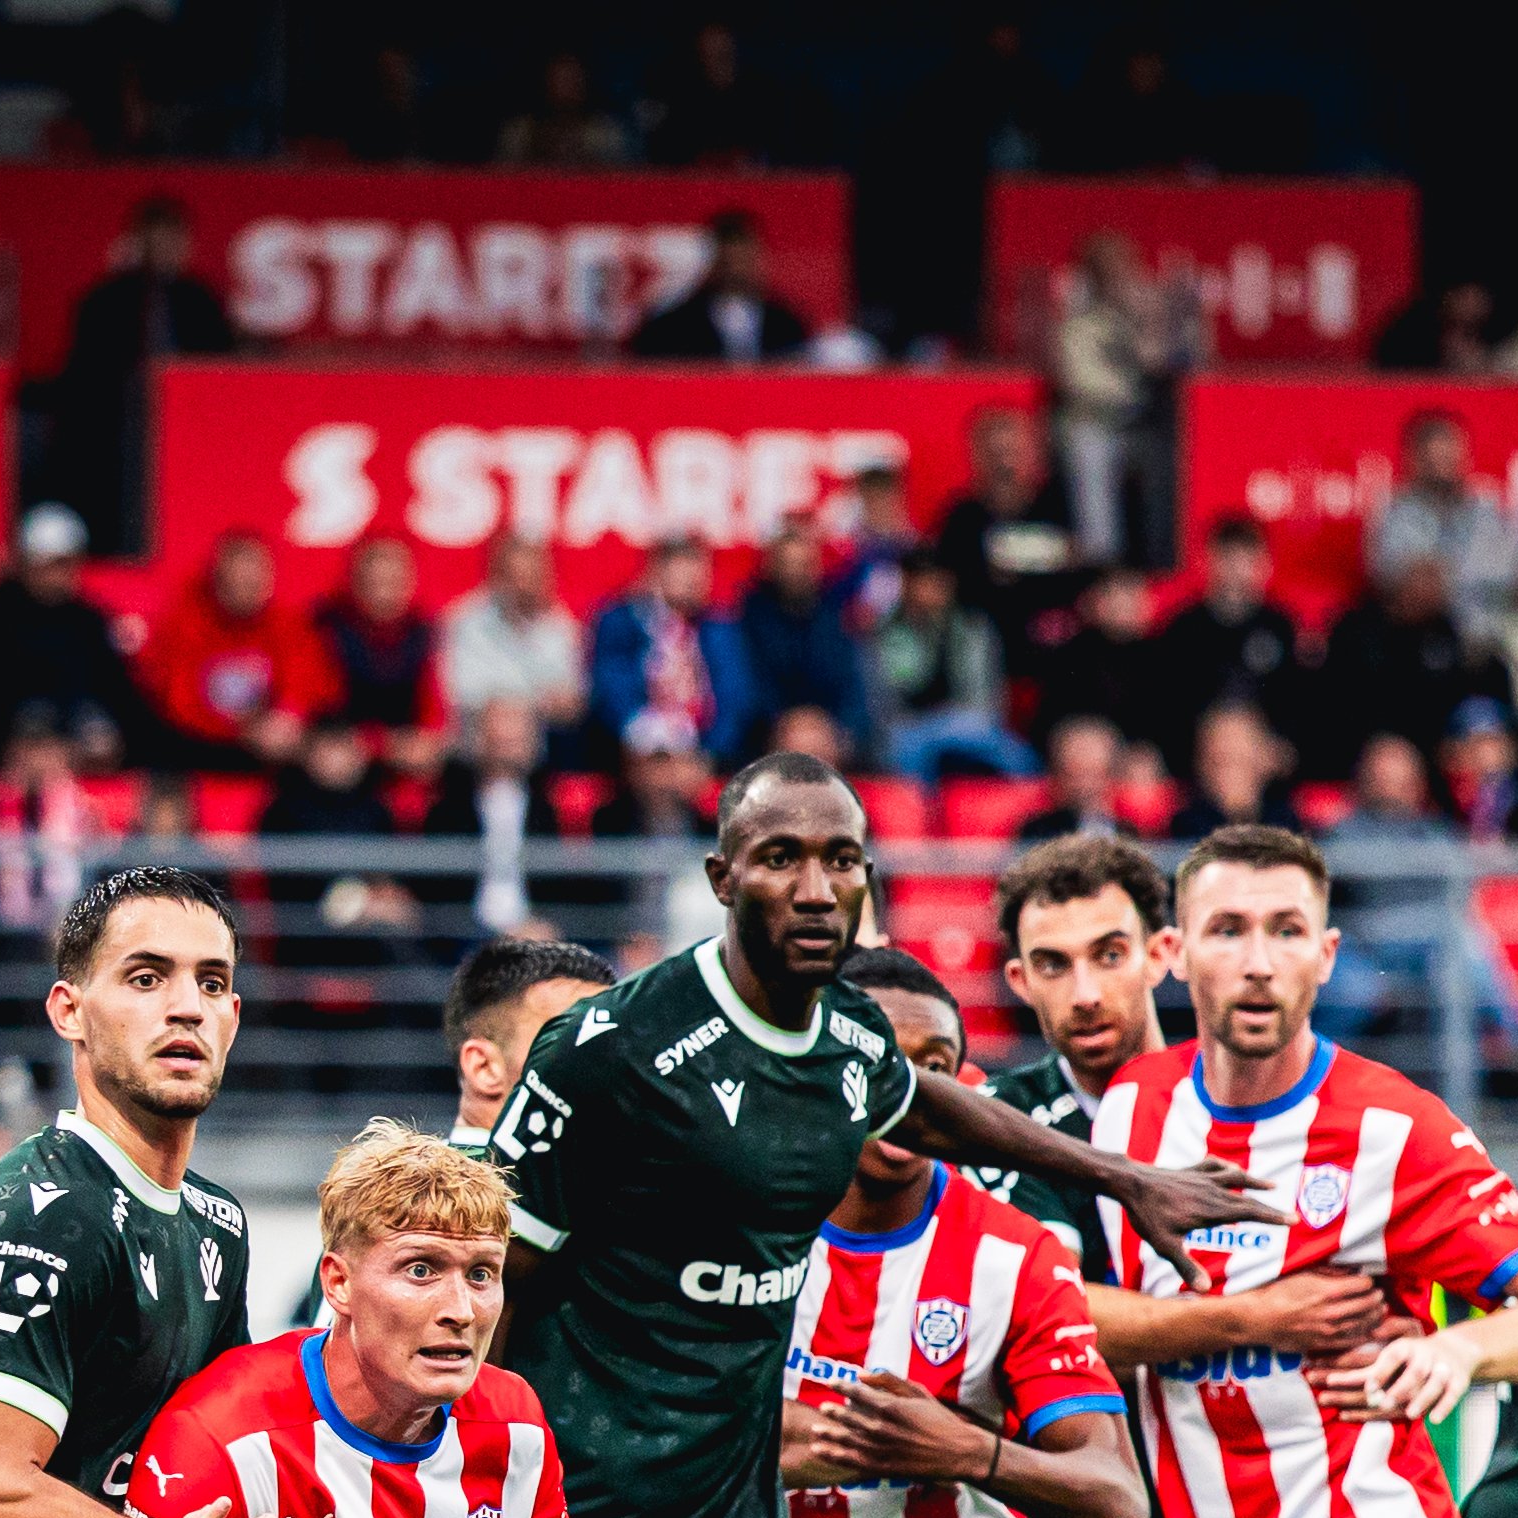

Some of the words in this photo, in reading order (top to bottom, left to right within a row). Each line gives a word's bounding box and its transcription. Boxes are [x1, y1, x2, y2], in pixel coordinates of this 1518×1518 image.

[654, 1016, 729, 1076] SYNER
[1184, 1227, 1271, 1249] ance
[679, 1257, 810, 1306] Chan
